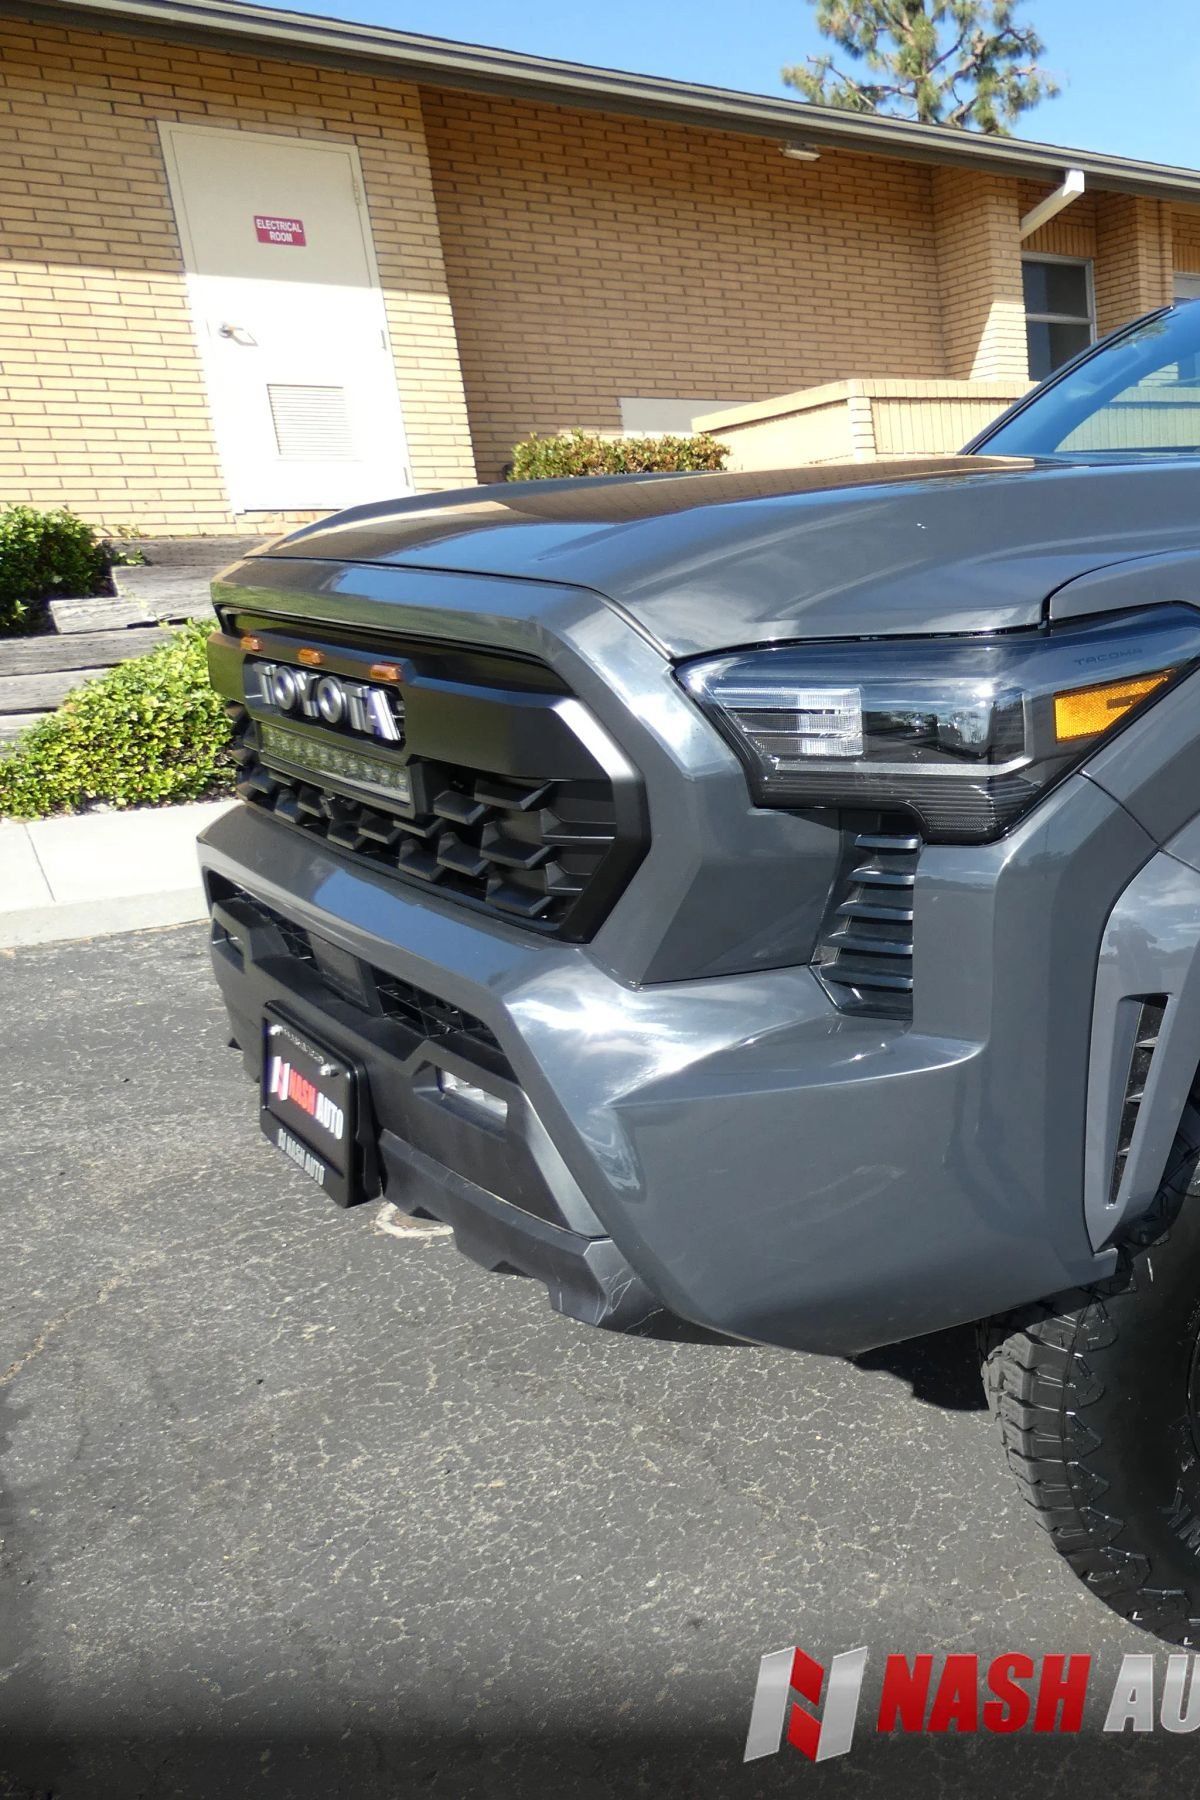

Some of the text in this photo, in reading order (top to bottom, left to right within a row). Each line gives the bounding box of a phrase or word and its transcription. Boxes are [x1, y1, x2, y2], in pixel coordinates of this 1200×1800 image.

[256, 218, 303, 232] ELECTRICAL
[269, 231, 293, 242] ROOM
[252, 661, 401, 741] TOYOTA
[288, 1068, 319, 1116] NASH
[315, 1091, 345, 1140] AUTO
